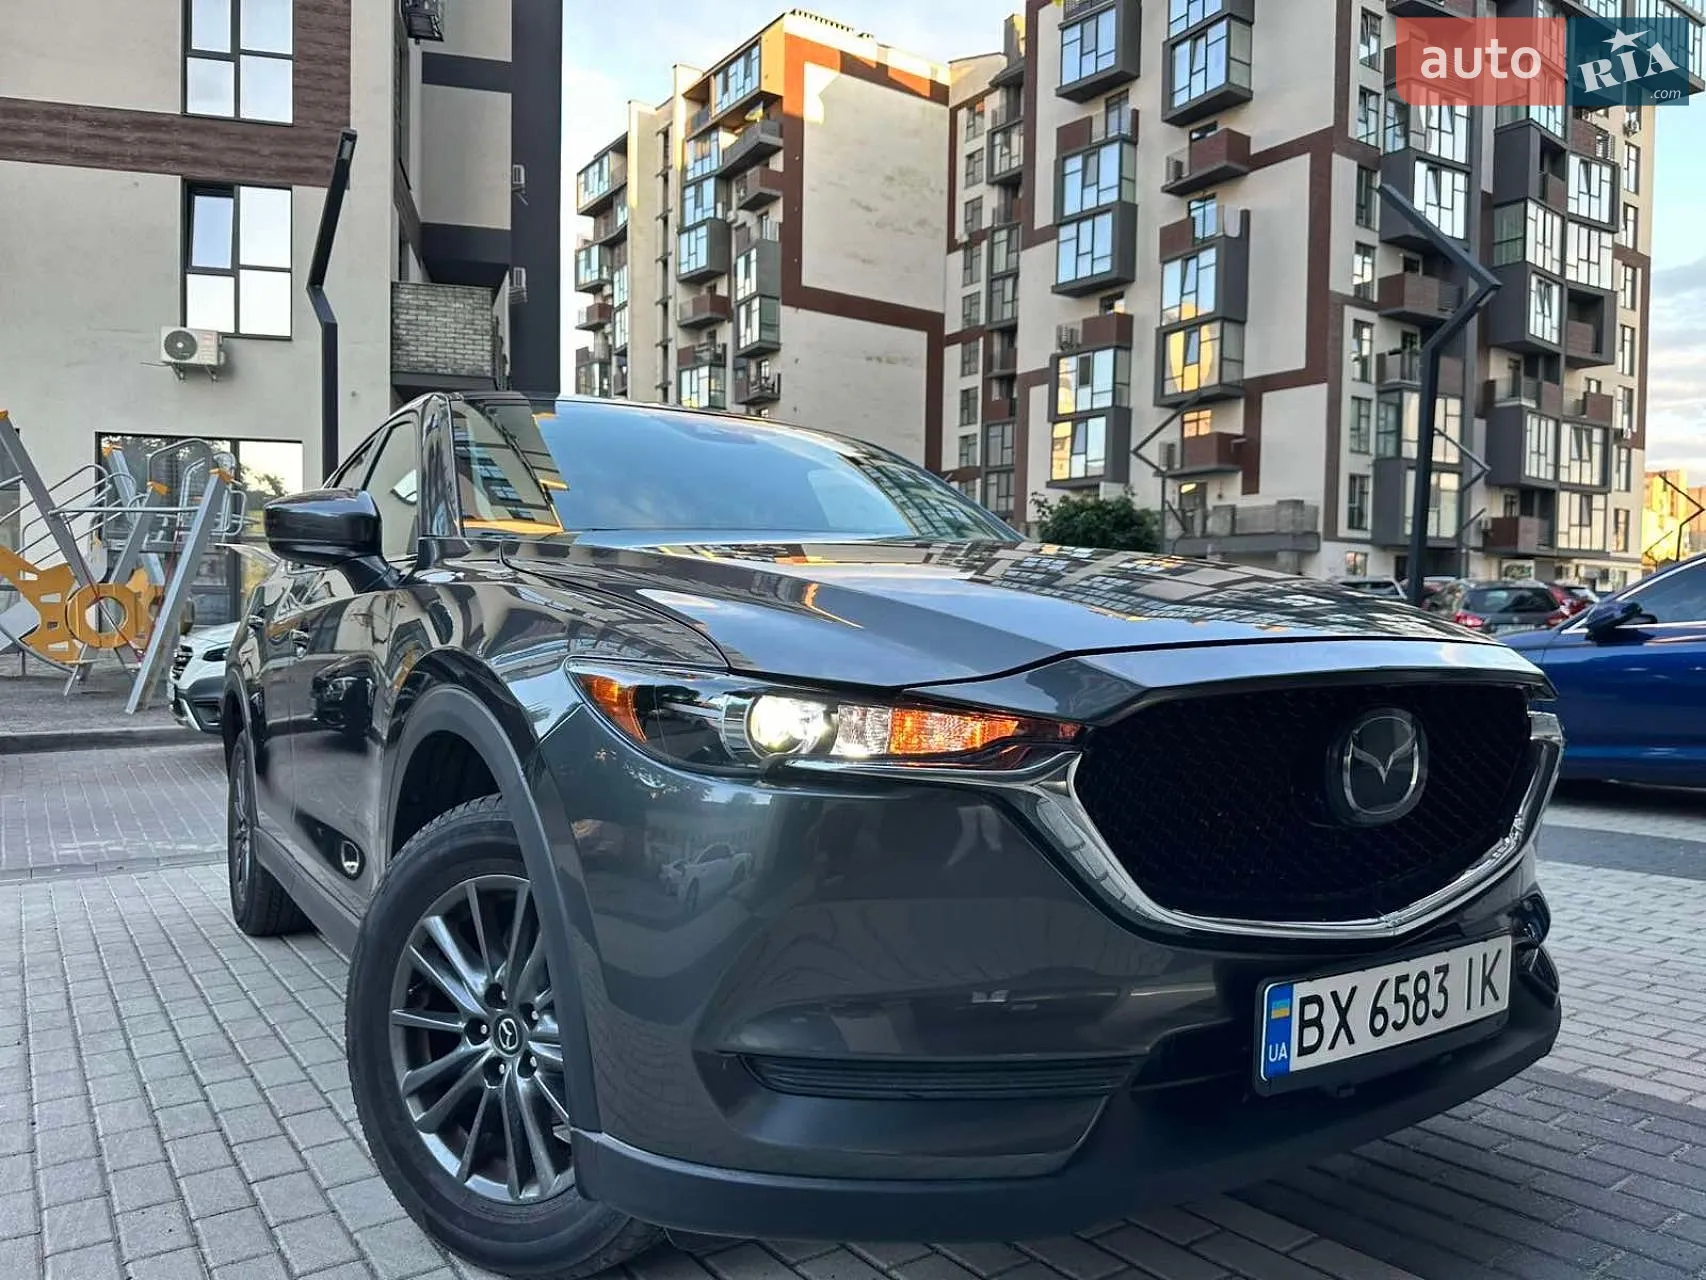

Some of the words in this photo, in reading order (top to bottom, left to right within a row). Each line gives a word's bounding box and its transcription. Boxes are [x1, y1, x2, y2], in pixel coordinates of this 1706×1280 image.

[1297, 986, 1357, 1057] BX
[1369, 964, 1449, 1037] 6583
[1466, 950, 1502, 1010] IK
[1268, 1044, 1288, 1062] UA
